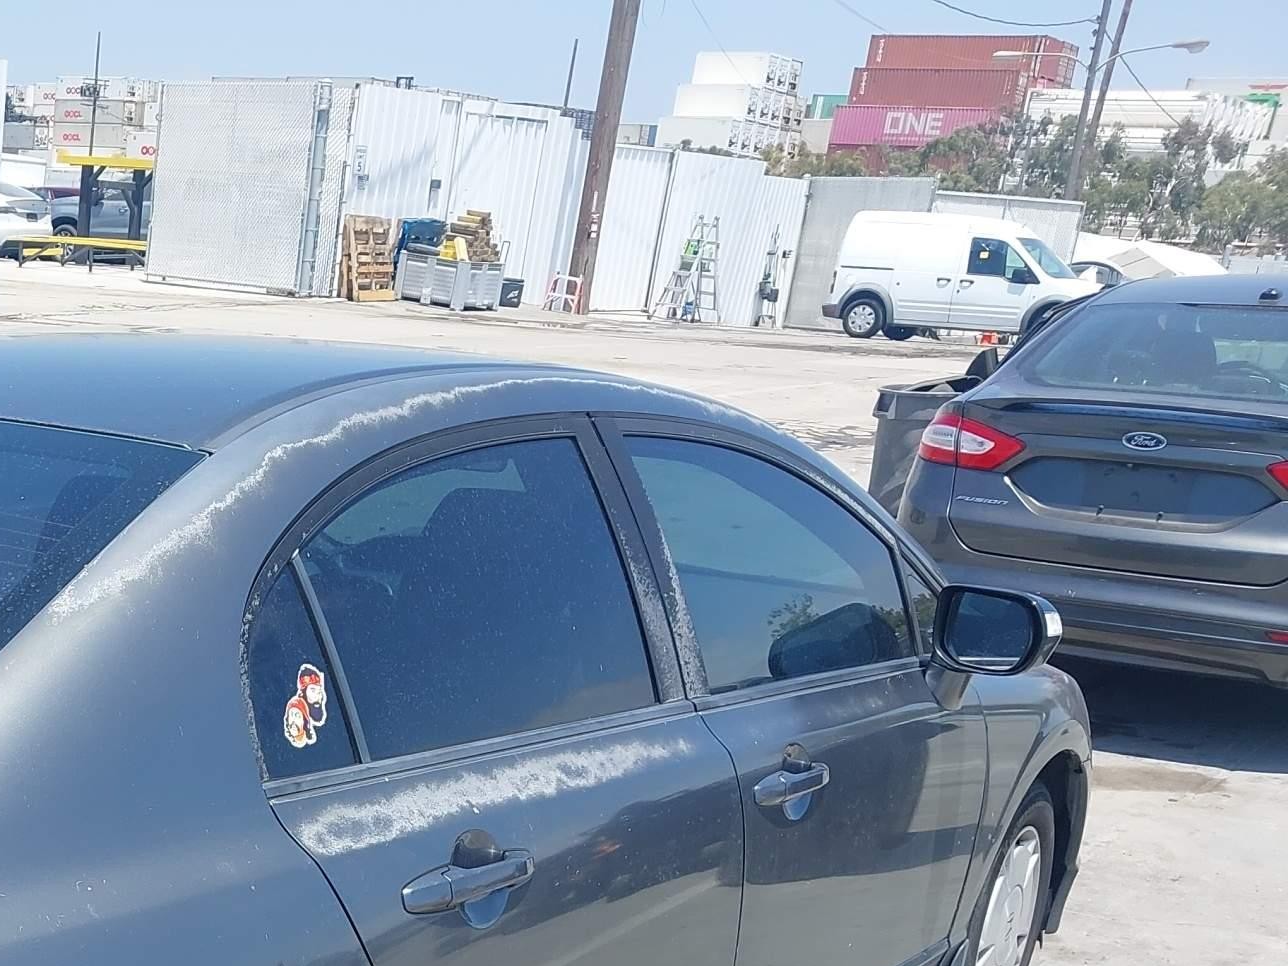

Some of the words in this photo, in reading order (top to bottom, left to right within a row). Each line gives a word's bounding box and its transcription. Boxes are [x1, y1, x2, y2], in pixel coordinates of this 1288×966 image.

[64, 110, 83, 118] OOCL
[883, 111, 944, 136] ONE
[62, 133, 81, 141] OOCL
[1128, 434, 1160, 448] Ford
